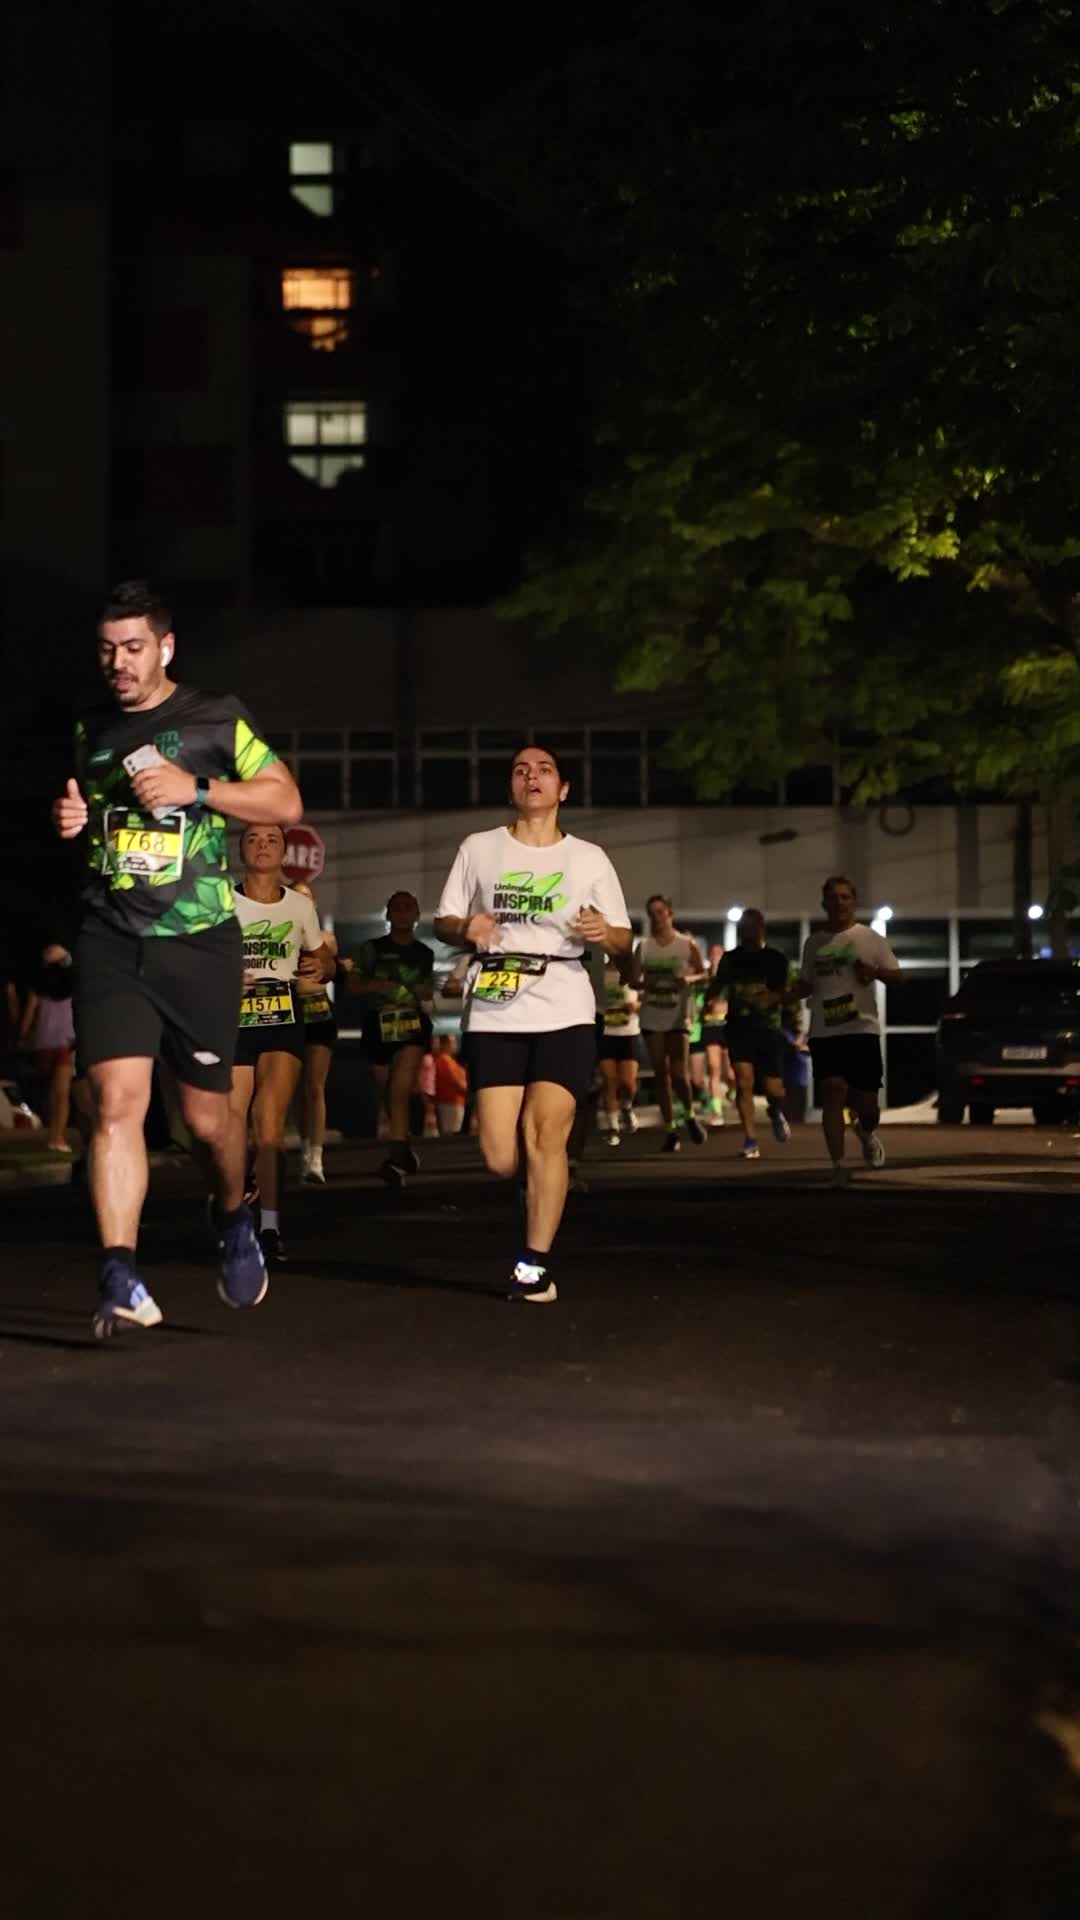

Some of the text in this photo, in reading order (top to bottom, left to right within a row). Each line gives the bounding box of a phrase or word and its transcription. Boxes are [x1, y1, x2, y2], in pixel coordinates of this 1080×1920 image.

[112, 830, 165, 852] 1768
[281, 845, 321, 869] ARE
[494, 883, 534, 893] Unimed
[493, 893, 553, 912] INSPIRA
[489, 972, 519, 989] 221
[247, 997, 281, 1012] 1571
